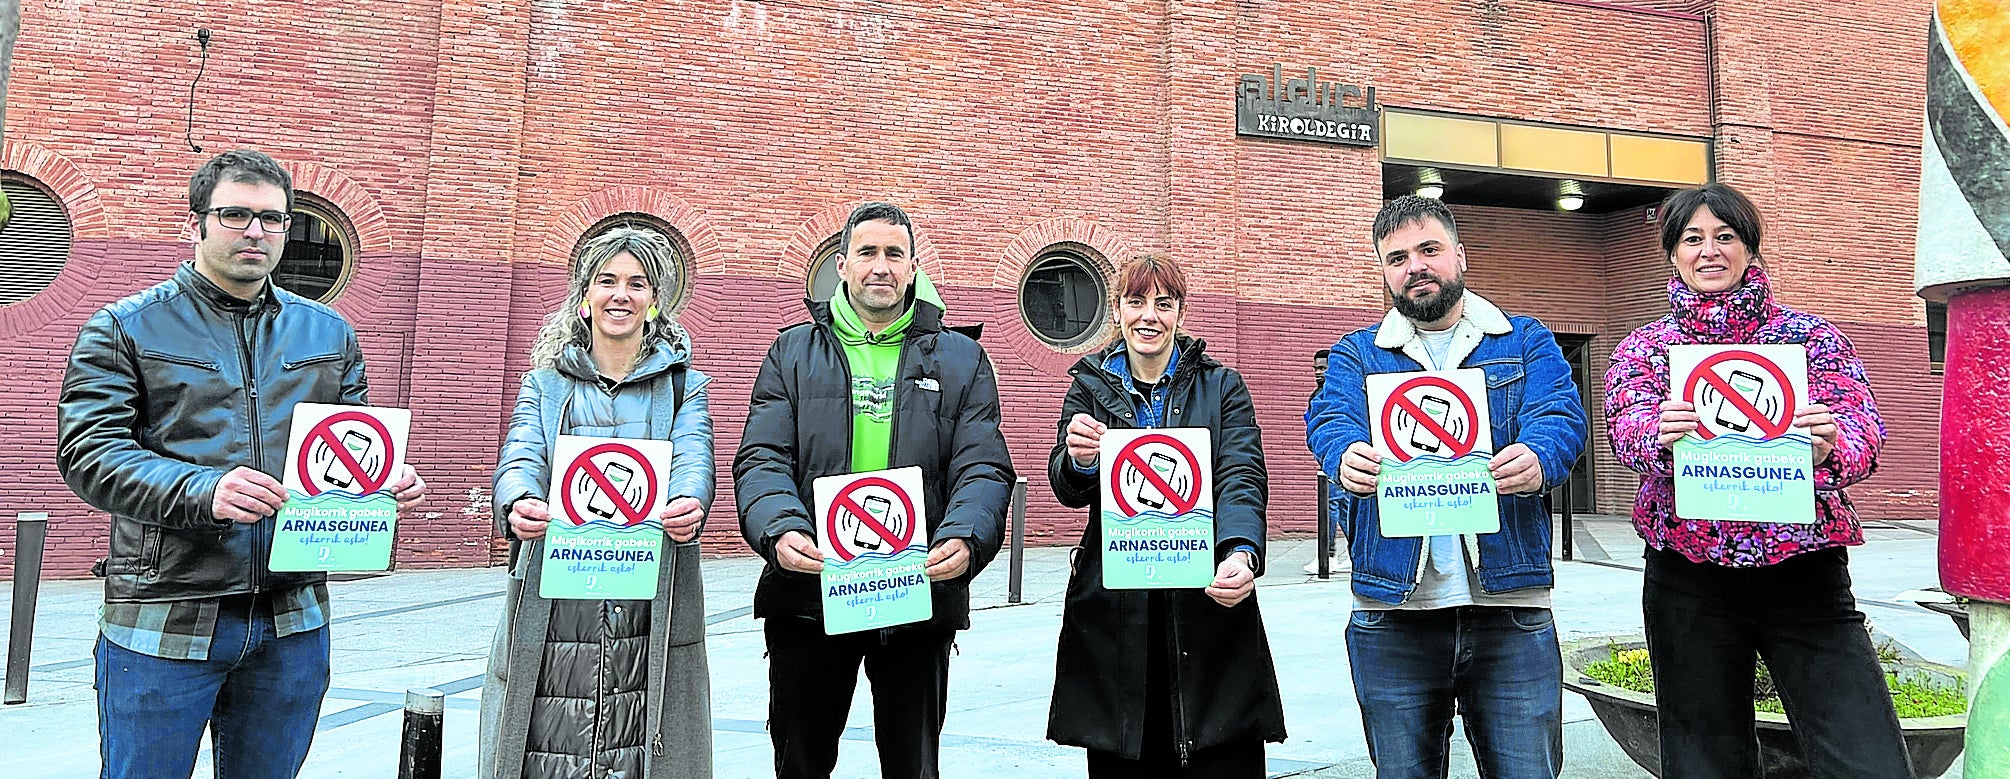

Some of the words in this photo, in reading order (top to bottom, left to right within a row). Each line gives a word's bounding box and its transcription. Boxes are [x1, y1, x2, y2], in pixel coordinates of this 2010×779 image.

[1680, 451, 1752, 464] Mugikorrik
[1753, 452, 1805, 466] gabeko
[1382, 471, 1444, 484] Mugikorrik
[1446, 470, 1489, 482] gabeko
[1682, 464, 1806, 480] ARNASGUNEA
[1384, 482, 1490, 498] ARNASGUNEA
[1703, 479, 1750, 492] eskerrik
[1754, 480, 1784, 495] asko!
[1404, 497, 1445, 510] eskerrik
[1447, 496, 1472, 509] asko!
[285, 506, 348, 519] Mugikorrik
[350, 507, 391, 519] gabeko
[282, 520, 388, 532] ARNASGUNEA
[300, 533, 342, 545] eskerrik
[344, 533, 369, 545] asko!
[1108, 527, 1166, 539] Mugikorrik
[1168, 527, 1209, 539] gabeko
[551, 536, 613, 548] Mugikorrik
[614, 537, 657, 549] gabeko
[1108, 539, 1209, 552] ARNASGUNEA
[549, 549, 654, 562] ARNASGUNEA
[1126, 552, 1164, 564] eskerrik
[1167, 552, 1191, 564] asko!
[567, 562, 607, 573] eskerrik
[610, 563, 636, 574] asko!
[827, 568, 884, 583] Mugikorrik
[885, 563, 925, 577] gabeko
[828, 573, 925, 597] ARNASGUNEA
[846, 592, 883, 607] eskerrik
[886, 588, 909, 601] asko!
